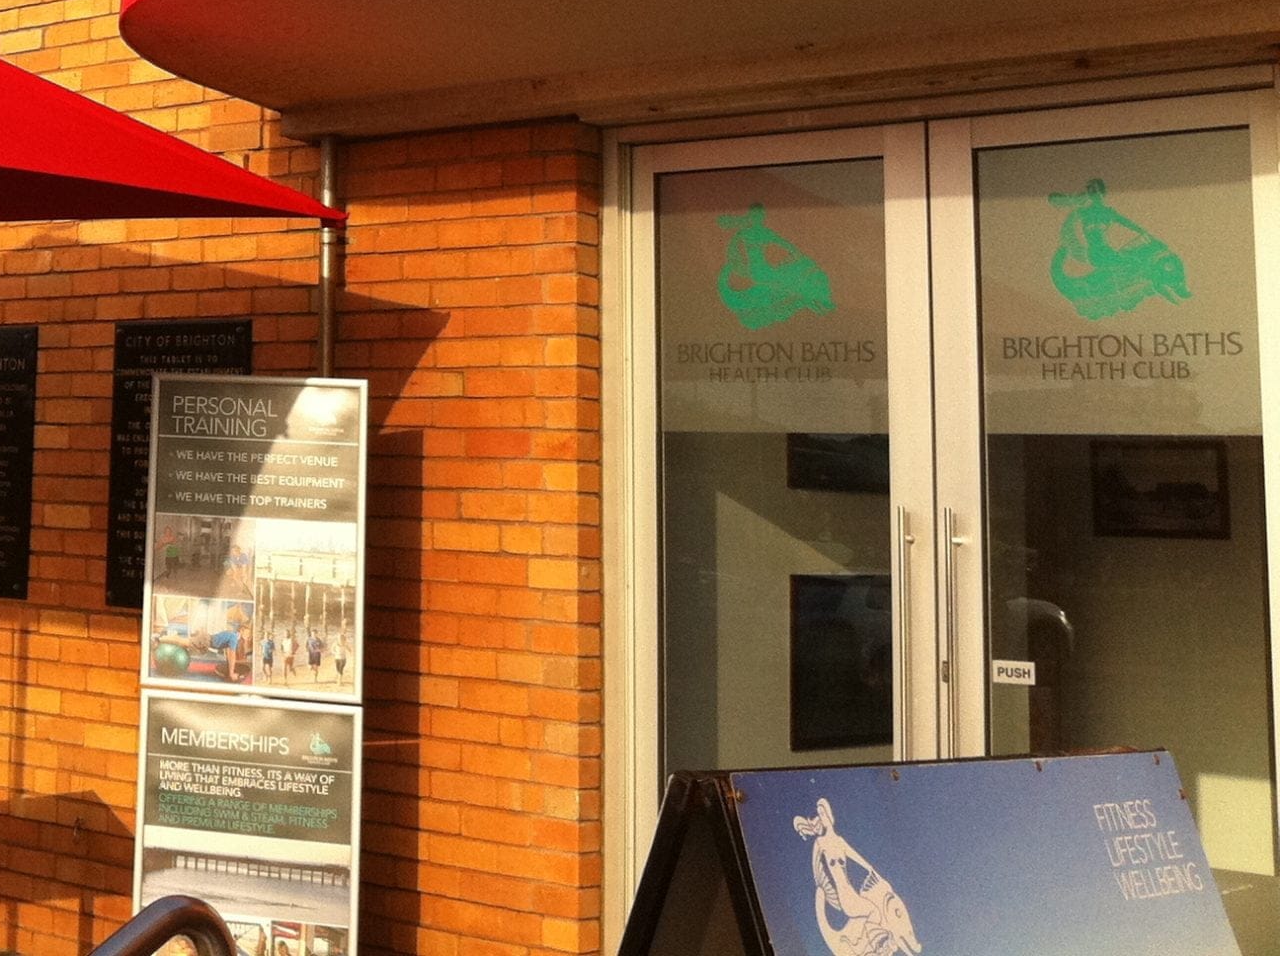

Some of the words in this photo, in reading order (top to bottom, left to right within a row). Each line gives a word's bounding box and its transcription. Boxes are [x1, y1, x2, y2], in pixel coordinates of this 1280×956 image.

[125, 336, 152, 348] CITY
[156, 335, 171, 347] OF
[175, 334, 235, 347] BRIGHTON
[677, 341, 793, 364] BRIGHTON
[801, 340, 876, 363] BATHS
[1002, 334, 1147, 361] BRIGHTON
[1154, 332, 1244, 356] BATHS
[709, 367, 779, 383] HEALTH
[784, 365, 833, 382] CLUB
[1042, 362, 1126, 381] HEALTH
[1132, 361, 1191, 379] CLUB
[173, 395, 278, 418] PERSONAL
[172, 416, 267, 438] TRAINING
[176, 450, 194, 460] WE
[196, 451, 224, 462] HAVE
[227, 452, 248, 463] THE
[251, 453, 298, 465] PERFECT
[299, 455, 339, 468] VENUE
[175, 471, 193, 481] WE
[196, 472, 224, 482] HAVE
[227, 473, 247, 484] THE
[250, 474, 277, 485] BEST
[278, 475, 345, 489] EQUIPMENT
[175, 492, 192, 502] WE
[195, 493, 223, 503] HAVE
[227, 494, 247, 505] THE
[249, 495, 273, 506] TOP
[275, 497, 328, 509] TRAINERS
[997, 667, 1031, 679] PUSH
[161, 727, 290, 755] MEMBERSHIPS
[159, 770, 192, 782] LIVING
[195, 774, 220, 784] THAT
[222, 776, 277, 790] EMBRACES
[278, 782, 329, 795] LIFESTYLE
[160, 759, 189, 771] MORE
[192, 763, 220, 774] THAN
[223, 766, 265, 780] FITNESS,
[268, 770, 282, 780] ITS
[284, 772, 292, 781] A
[294, 772, 317, 783] WAY
[319, 775, 335, 785] OF
[159, 781, 182, 791] AND
[159, 793, 206, 806] OFFERING
[207, 798, 215, 806] A
[217, 799, 251, 811] RANGE
[252, 802, 267, 812] OF
[269, 803, 337, 819] MEMBERSHIPS
[159, 804, 212, 817] INCLUDING
[213, 809, 240, 819] SWIM
[241, 812, 249, 820] &
[1093, 800, 1157, 832] FITNESS
[159, 814, 180, 824] AND
[182, 816, 226, 829] PREMIUM
[1105, 831, 1183, 867] LIFESTYLE
[1114, 862, 1203, 901] WELLBEING
